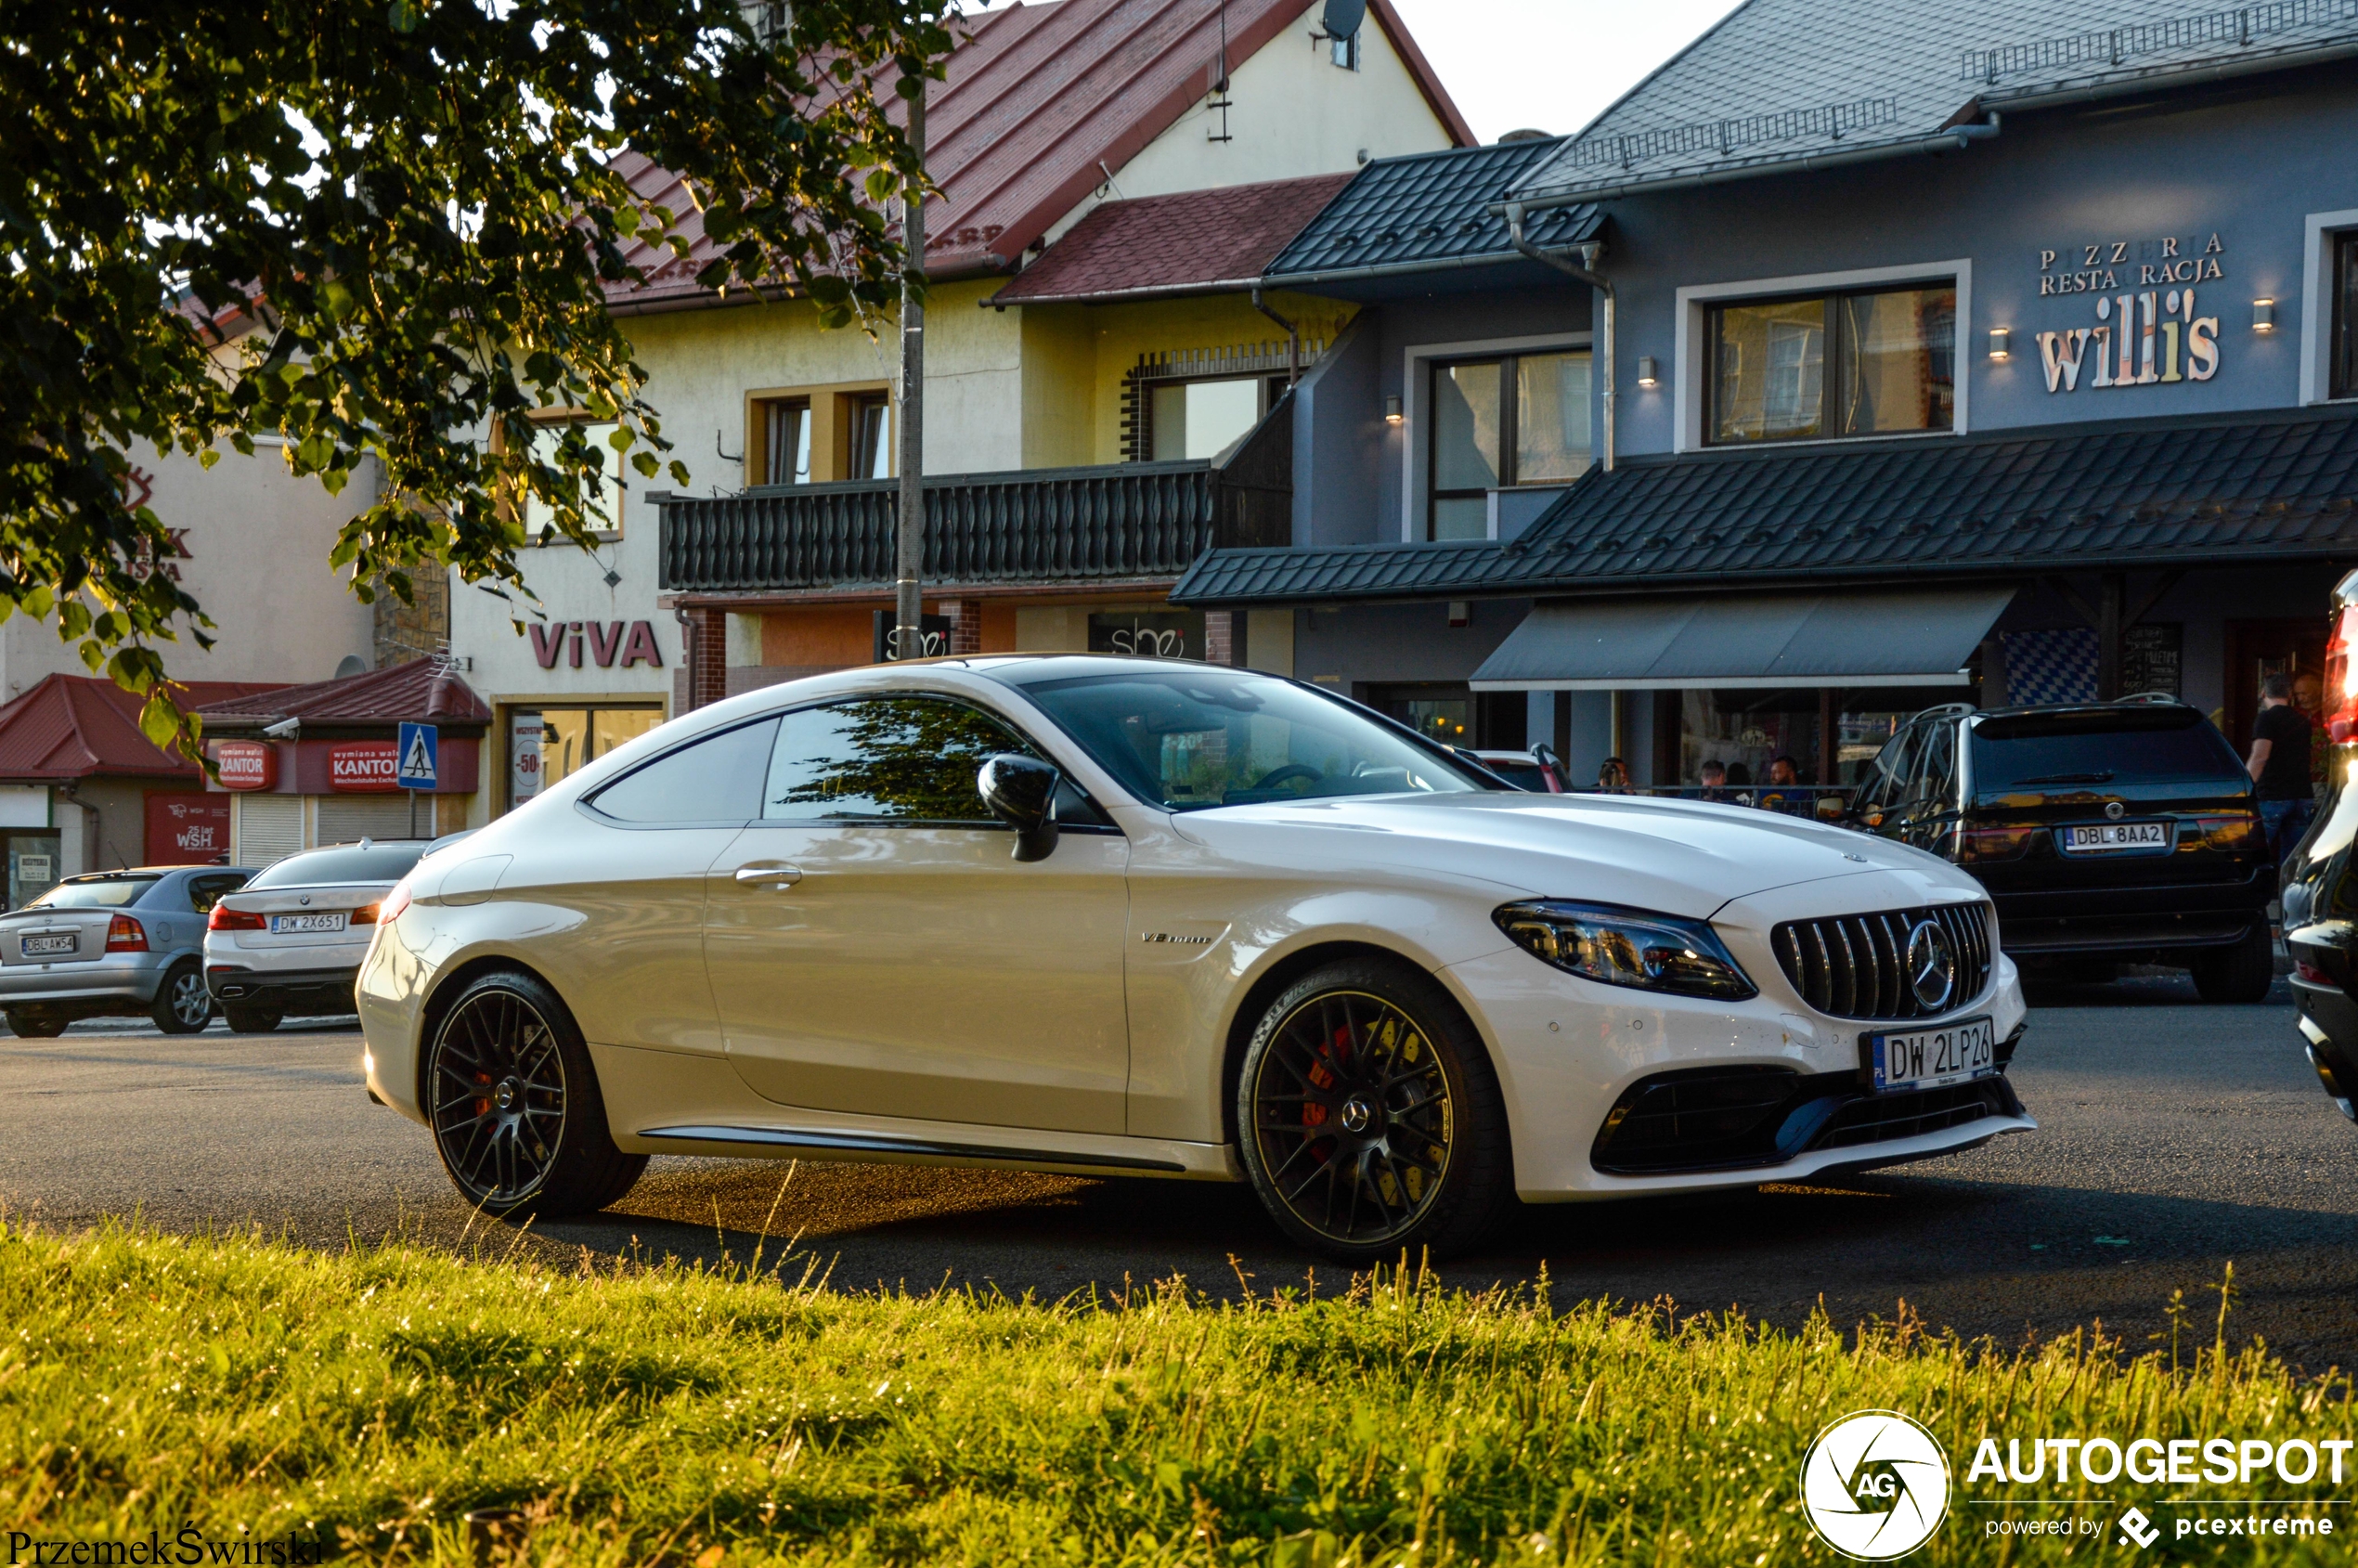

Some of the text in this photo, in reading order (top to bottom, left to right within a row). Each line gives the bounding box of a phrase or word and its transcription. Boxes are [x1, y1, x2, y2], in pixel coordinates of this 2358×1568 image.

[2036, 288, 2220, 393] willi's
[528, 620, 663, 668] ViVA
[333, 750, 375, 758] wymiana
[219, 758, 264, 773] KANTOR
[188, 825, 214, 834] 25 lat
[2077, 825, 2160, 845] DBL 8AA2
[176, 833, 212, 848] WSH
[280, 914, 340, 929] DW 2X651
[28, 937, 73, 952] DBL AW54
[1142, 932, 1167, 942] V8
[1891, 1024, 1989, 1080] DW 2LP26
